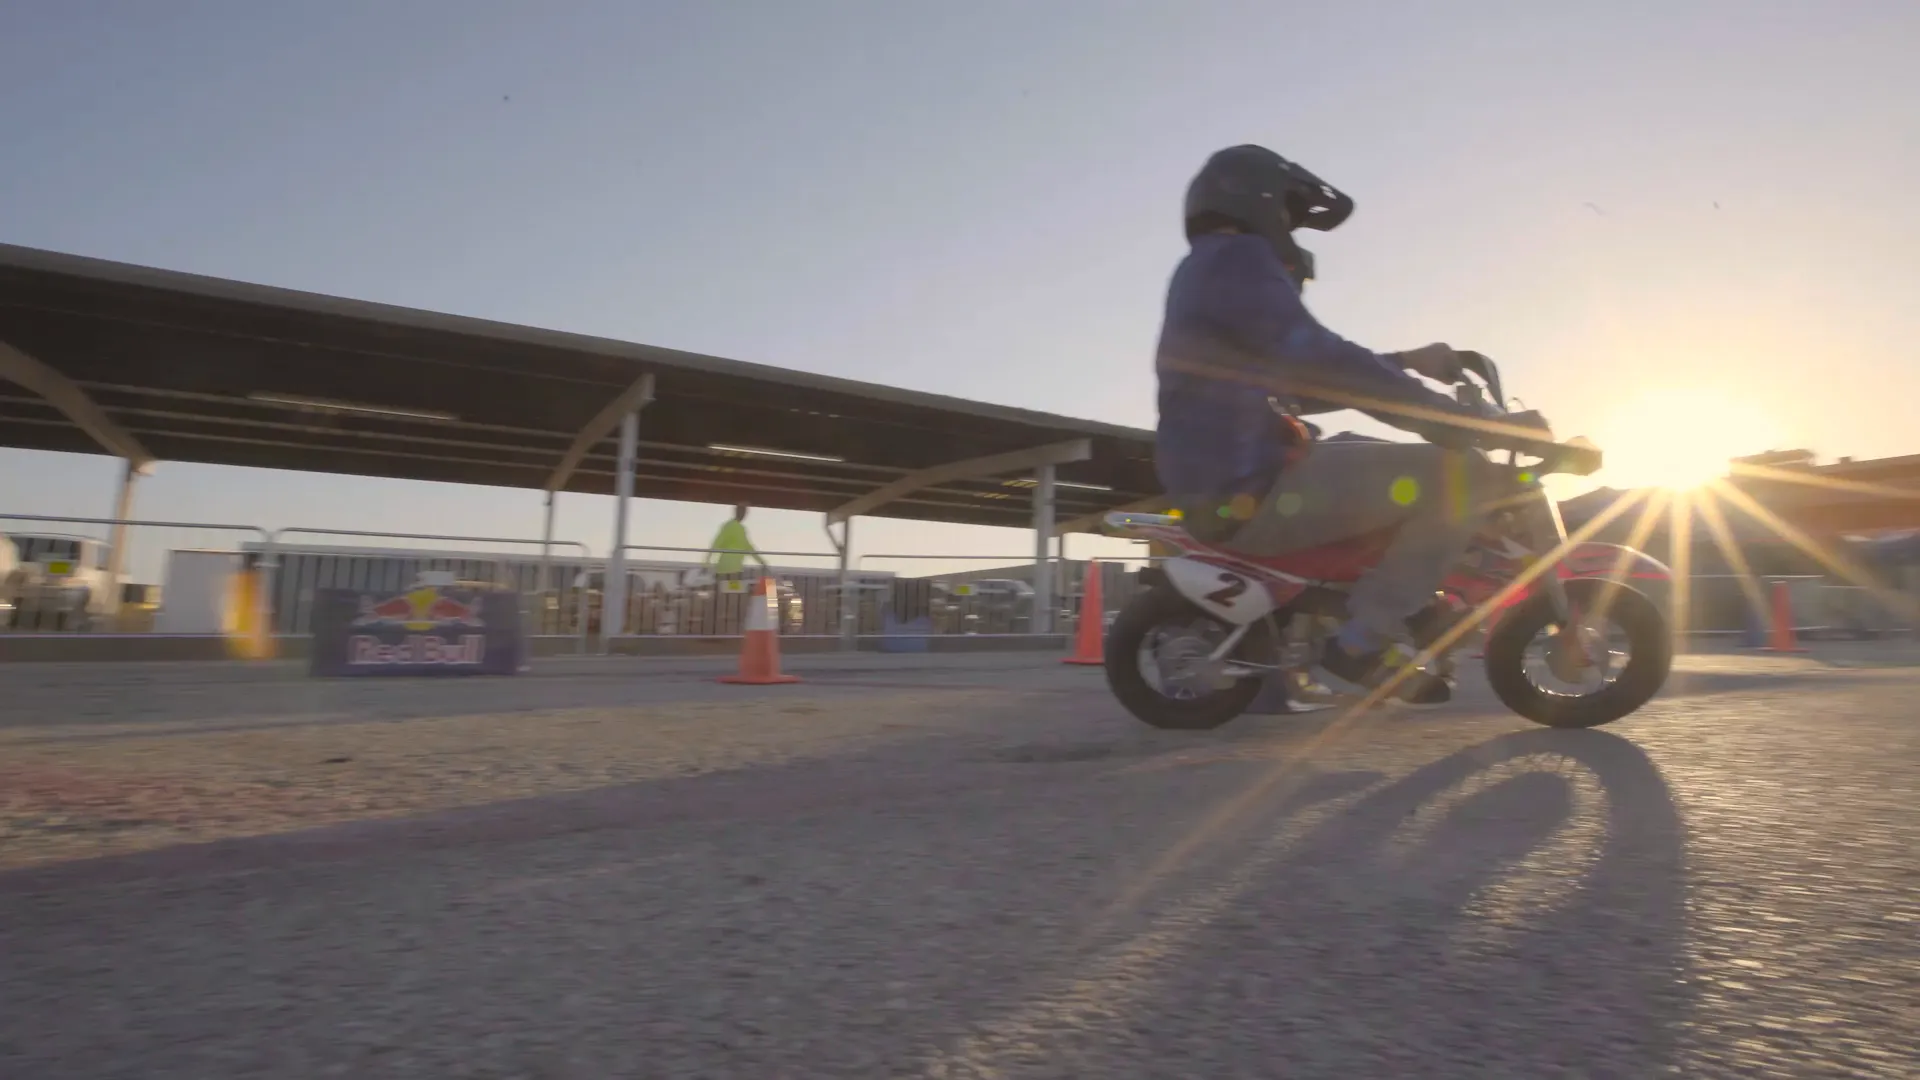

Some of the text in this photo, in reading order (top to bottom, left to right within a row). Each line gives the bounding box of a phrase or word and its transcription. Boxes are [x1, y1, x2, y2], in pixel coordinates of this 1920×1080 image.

[1204, 572, 1247, 608] 2
[348, 634, 485, 665] Red Bull
